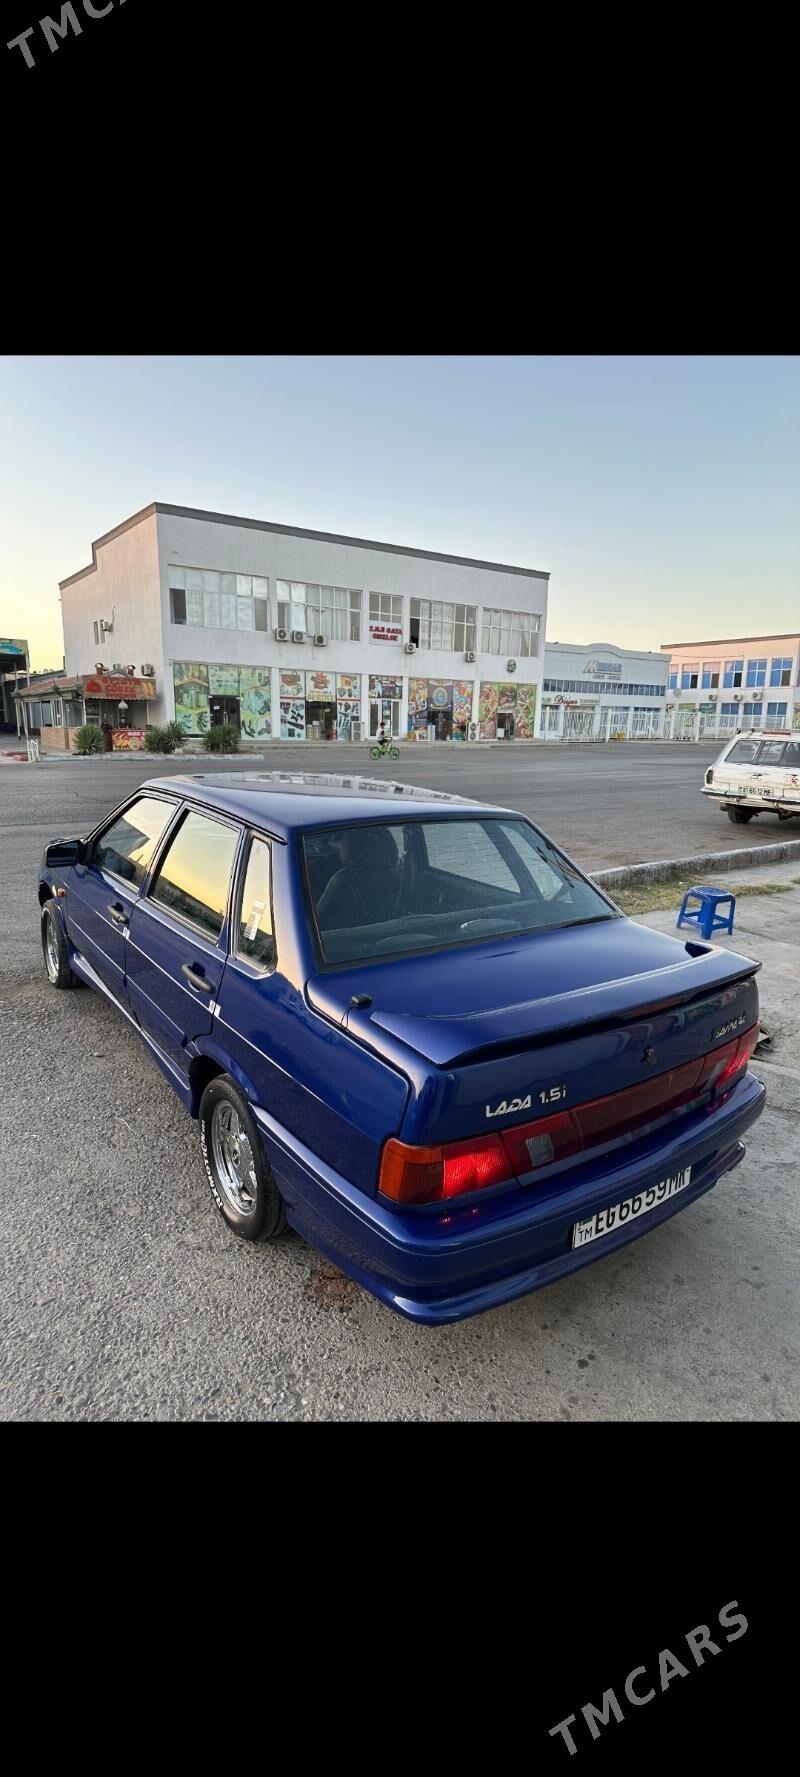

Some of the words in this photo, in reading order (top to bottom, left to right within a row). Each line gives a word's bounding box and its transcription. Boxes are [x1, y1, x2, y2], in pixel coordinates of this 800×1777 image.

[485, 1095, 532, 1118] LADA
[540, 1084, 566, 1104] 1.5i
[579, 1226, 592, 1242] TM
